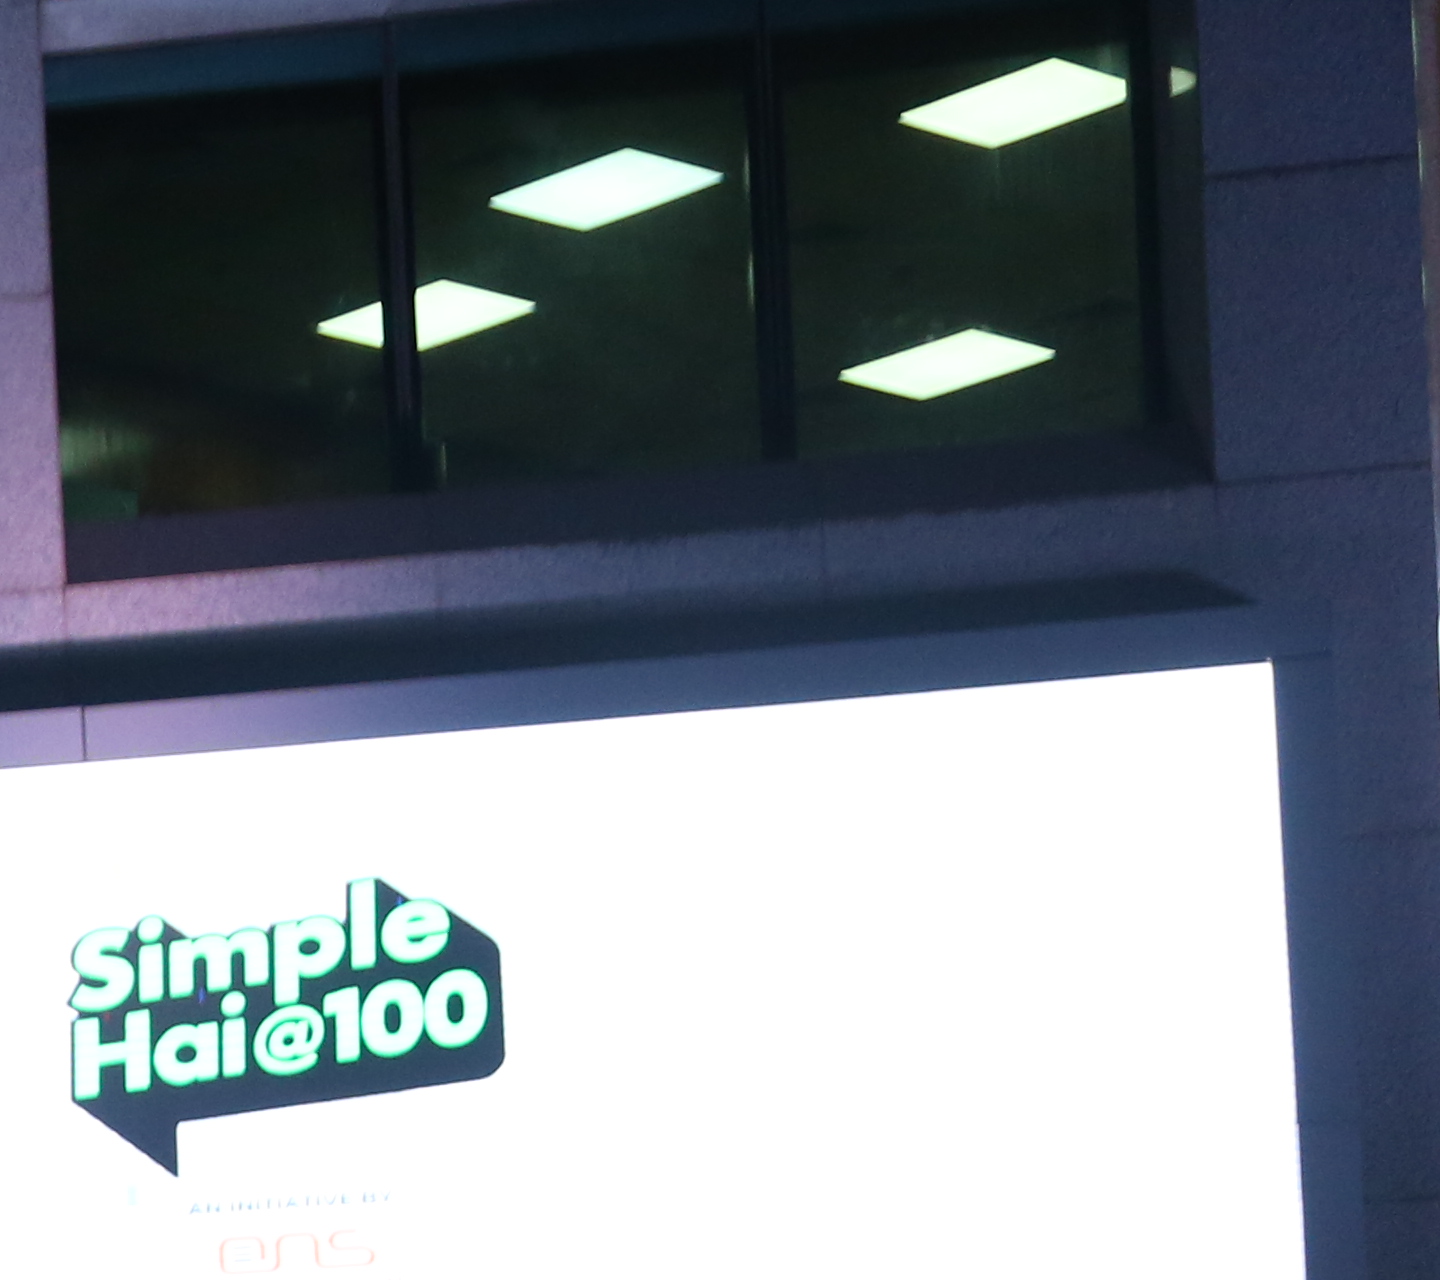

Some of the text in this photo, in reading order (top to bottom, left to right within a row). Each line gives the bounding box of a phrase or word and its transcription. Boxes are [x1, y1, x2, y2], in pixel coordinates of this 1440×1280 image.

[71, 877, 451, 1011] Simple
[72, 966, 489, 1100] Hai@100
[189, 1189, 392, 1215] AN INITIATIVE BY
